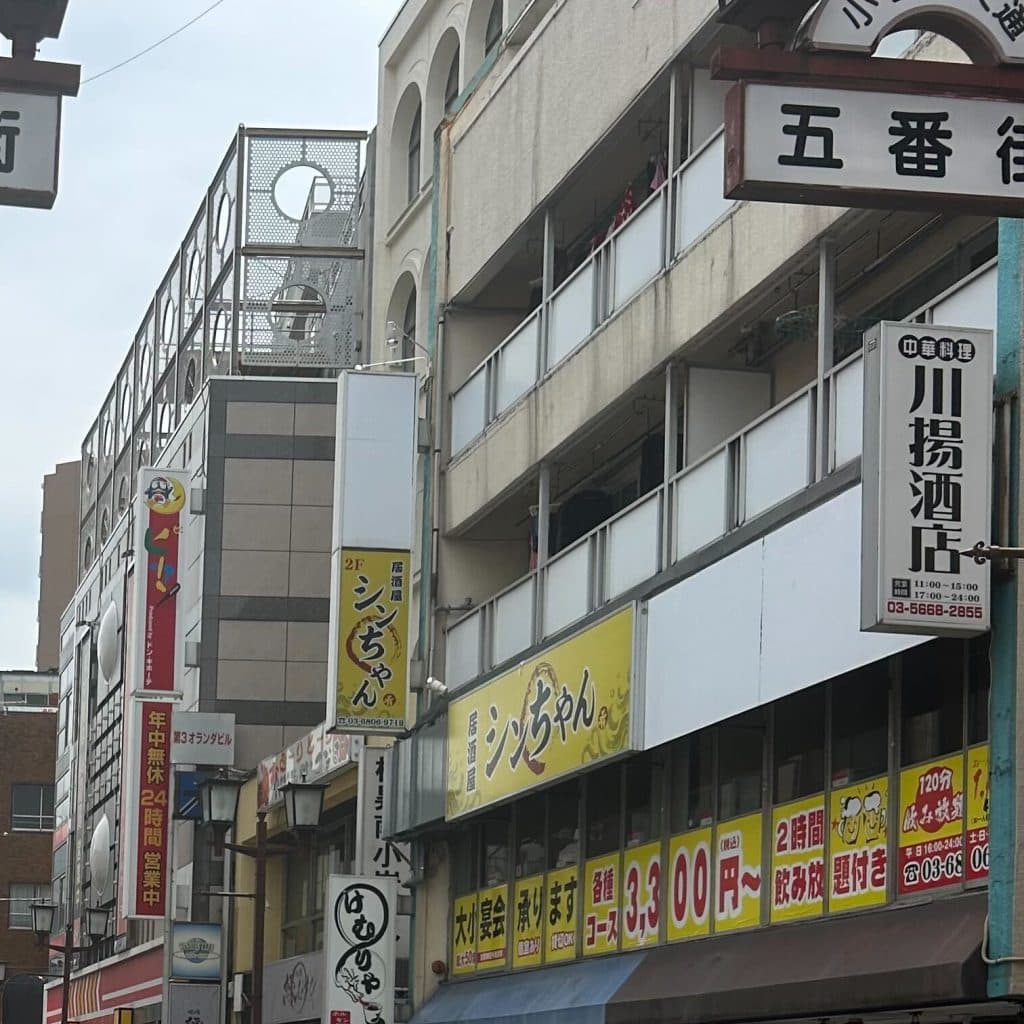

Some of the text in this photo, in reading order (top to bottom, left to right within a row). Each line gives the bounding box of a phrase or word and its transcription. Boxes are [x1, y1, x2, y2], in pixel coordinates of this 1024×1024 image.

[901, 336, 975, 362] 中華料理
[908, 364, 964, 575] 川揚酒店
[344, 557, 365, 571] 2F
[390, 561, 404, 602] 居酒屋
[352, 574, 399, 708] シンちゃん
[484, 669, 596, 780] シンちゃん
[918, 768, 953, 795] 120分
[140, 710, 168, 908] 年中無休 24時間 営業中
[776, 807, 824, 853] 2時間
[592, 867, 615, 904] 各種
[586, 910, 618, 947] コース
